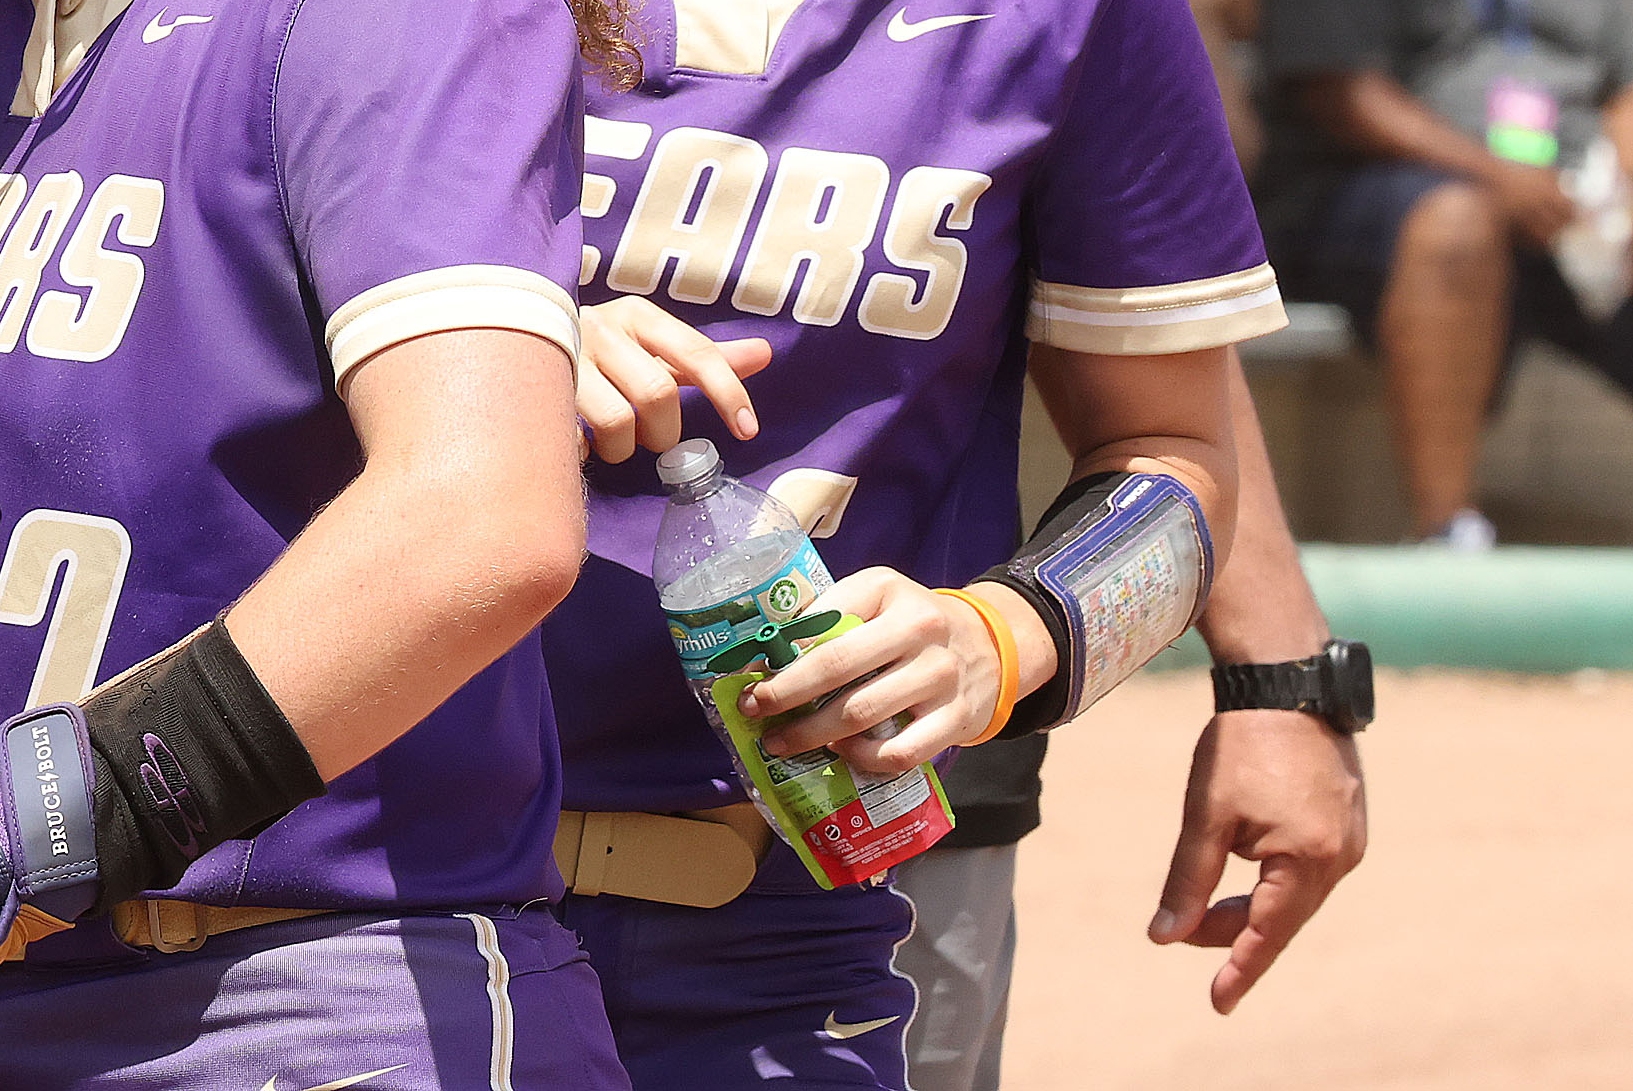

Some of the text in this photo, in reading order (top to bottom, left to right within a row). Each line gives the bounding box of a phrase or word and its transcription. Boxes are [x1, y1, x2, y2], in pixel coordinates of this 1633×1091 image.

[579, 114, 994, 341] EARS
[31, 725, 69, 857] BRUCE BOLT
